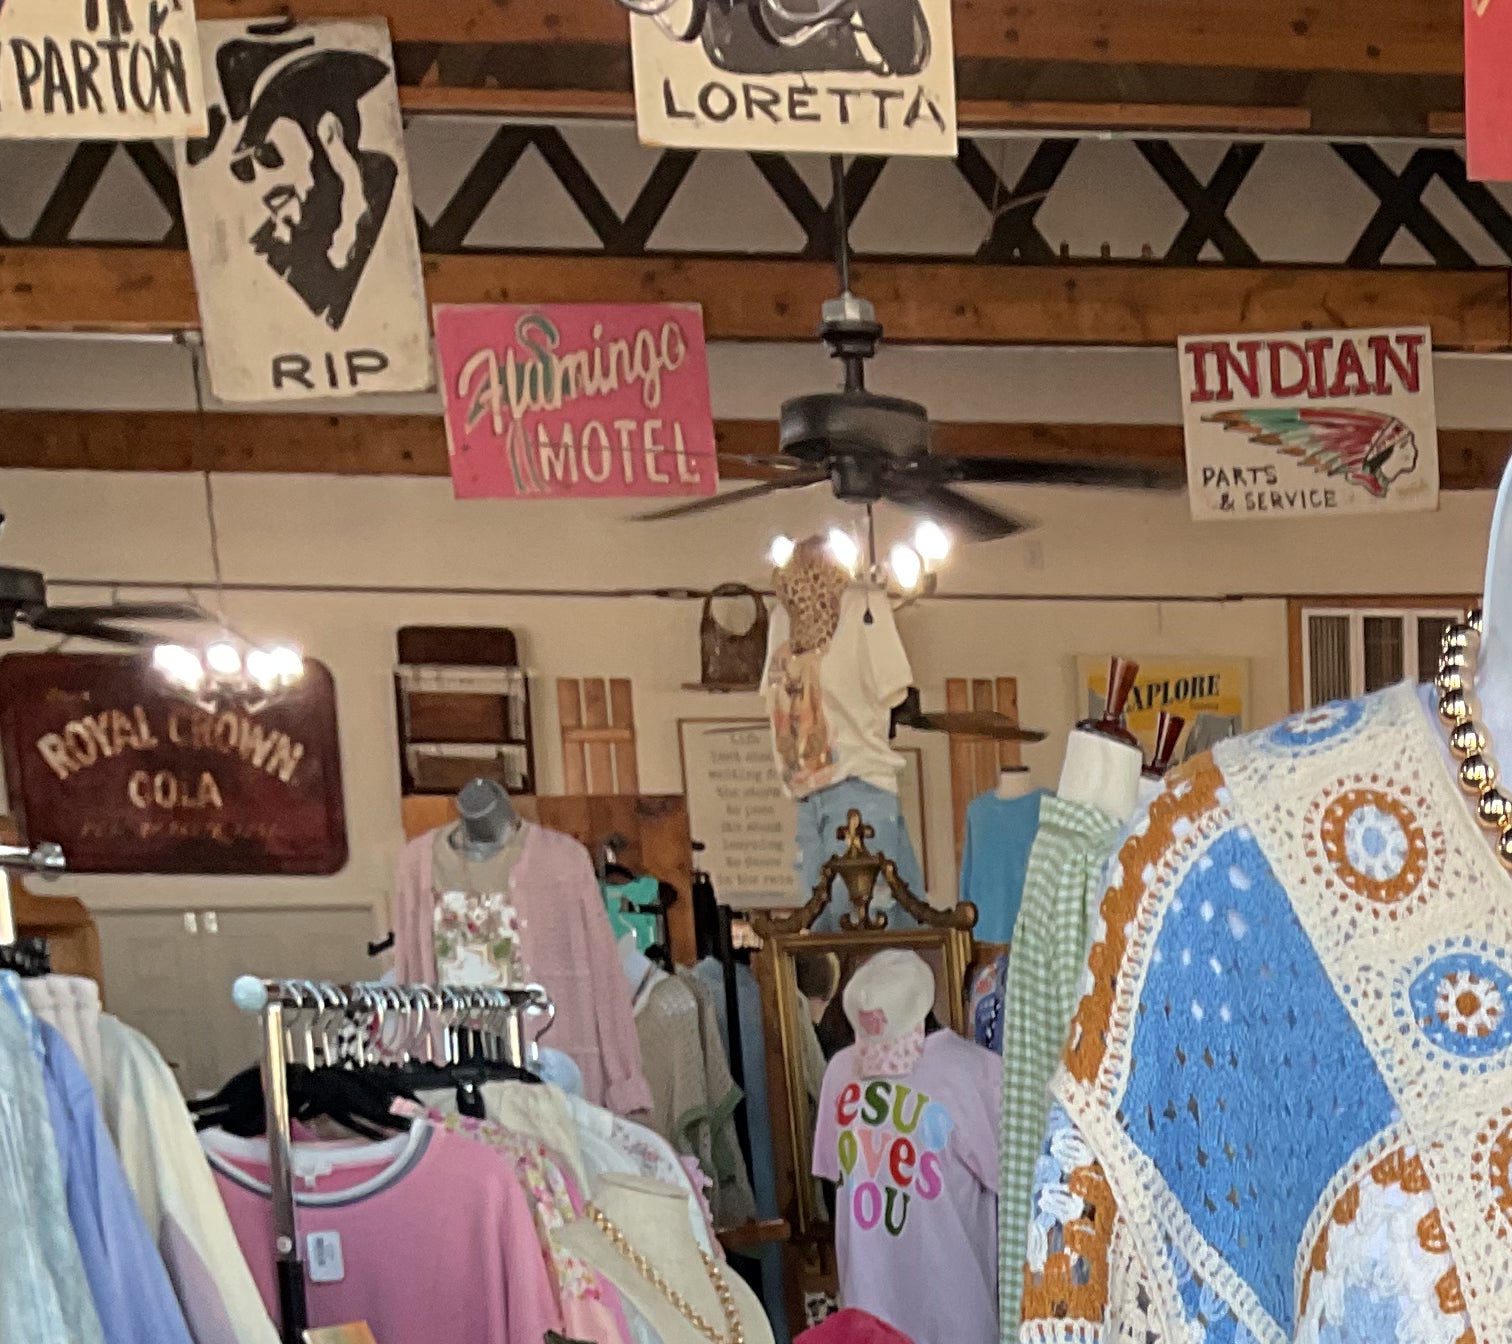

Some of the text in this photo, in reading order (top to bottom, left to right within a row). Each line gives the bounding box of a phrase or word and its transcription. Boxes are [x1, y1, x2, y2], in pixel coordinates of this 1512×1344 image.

[9, 36, 192, 115] PARTON
[662, 76, 946, 135] LORETTA
[272, 348, 389, 390] RIP
[458, 321, 686, 435] Flamingo
[1184, 334, 1426, 403] INDIAN
[537, 418, 701, 484] MOTEL
[1202, 464, 1279, 488] PARTS
[1220, 488, 1338, 511] & SERVICE
[1127, 672, 1221, 712] XPLORE
[37, 704, 304, 783] ROYAL CROWN
[127, 770, 224, 810] COLA
[837, 1129, 943, 1201] oves
[850, 1181, 911, 1237] ou
